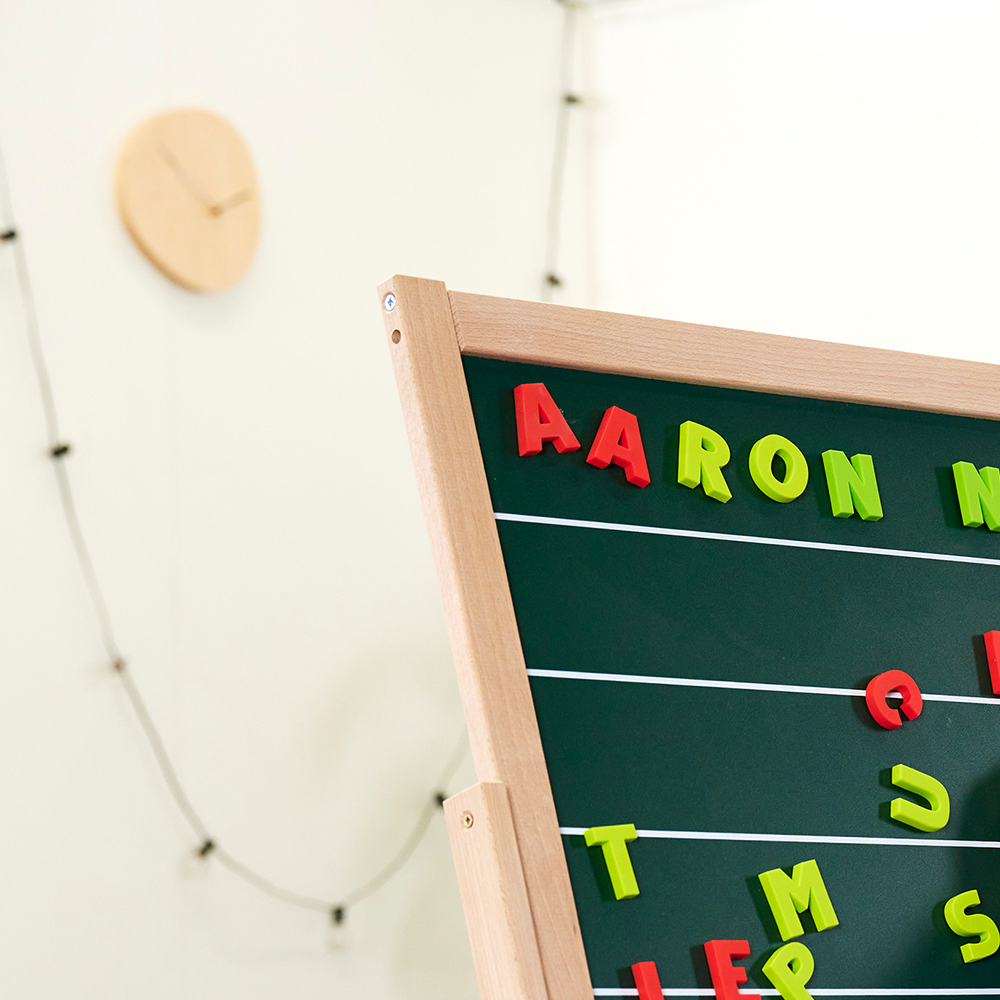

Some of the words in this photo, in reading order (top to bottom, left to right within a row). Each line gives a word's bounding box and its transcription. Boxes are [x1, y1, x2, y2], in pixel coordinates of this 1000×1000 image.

[513, 382, 884, 522] AARON
[584, 823, 641, 901] T
[757, 858, 840, 942] M
[943, 889, 1000, 964] S
